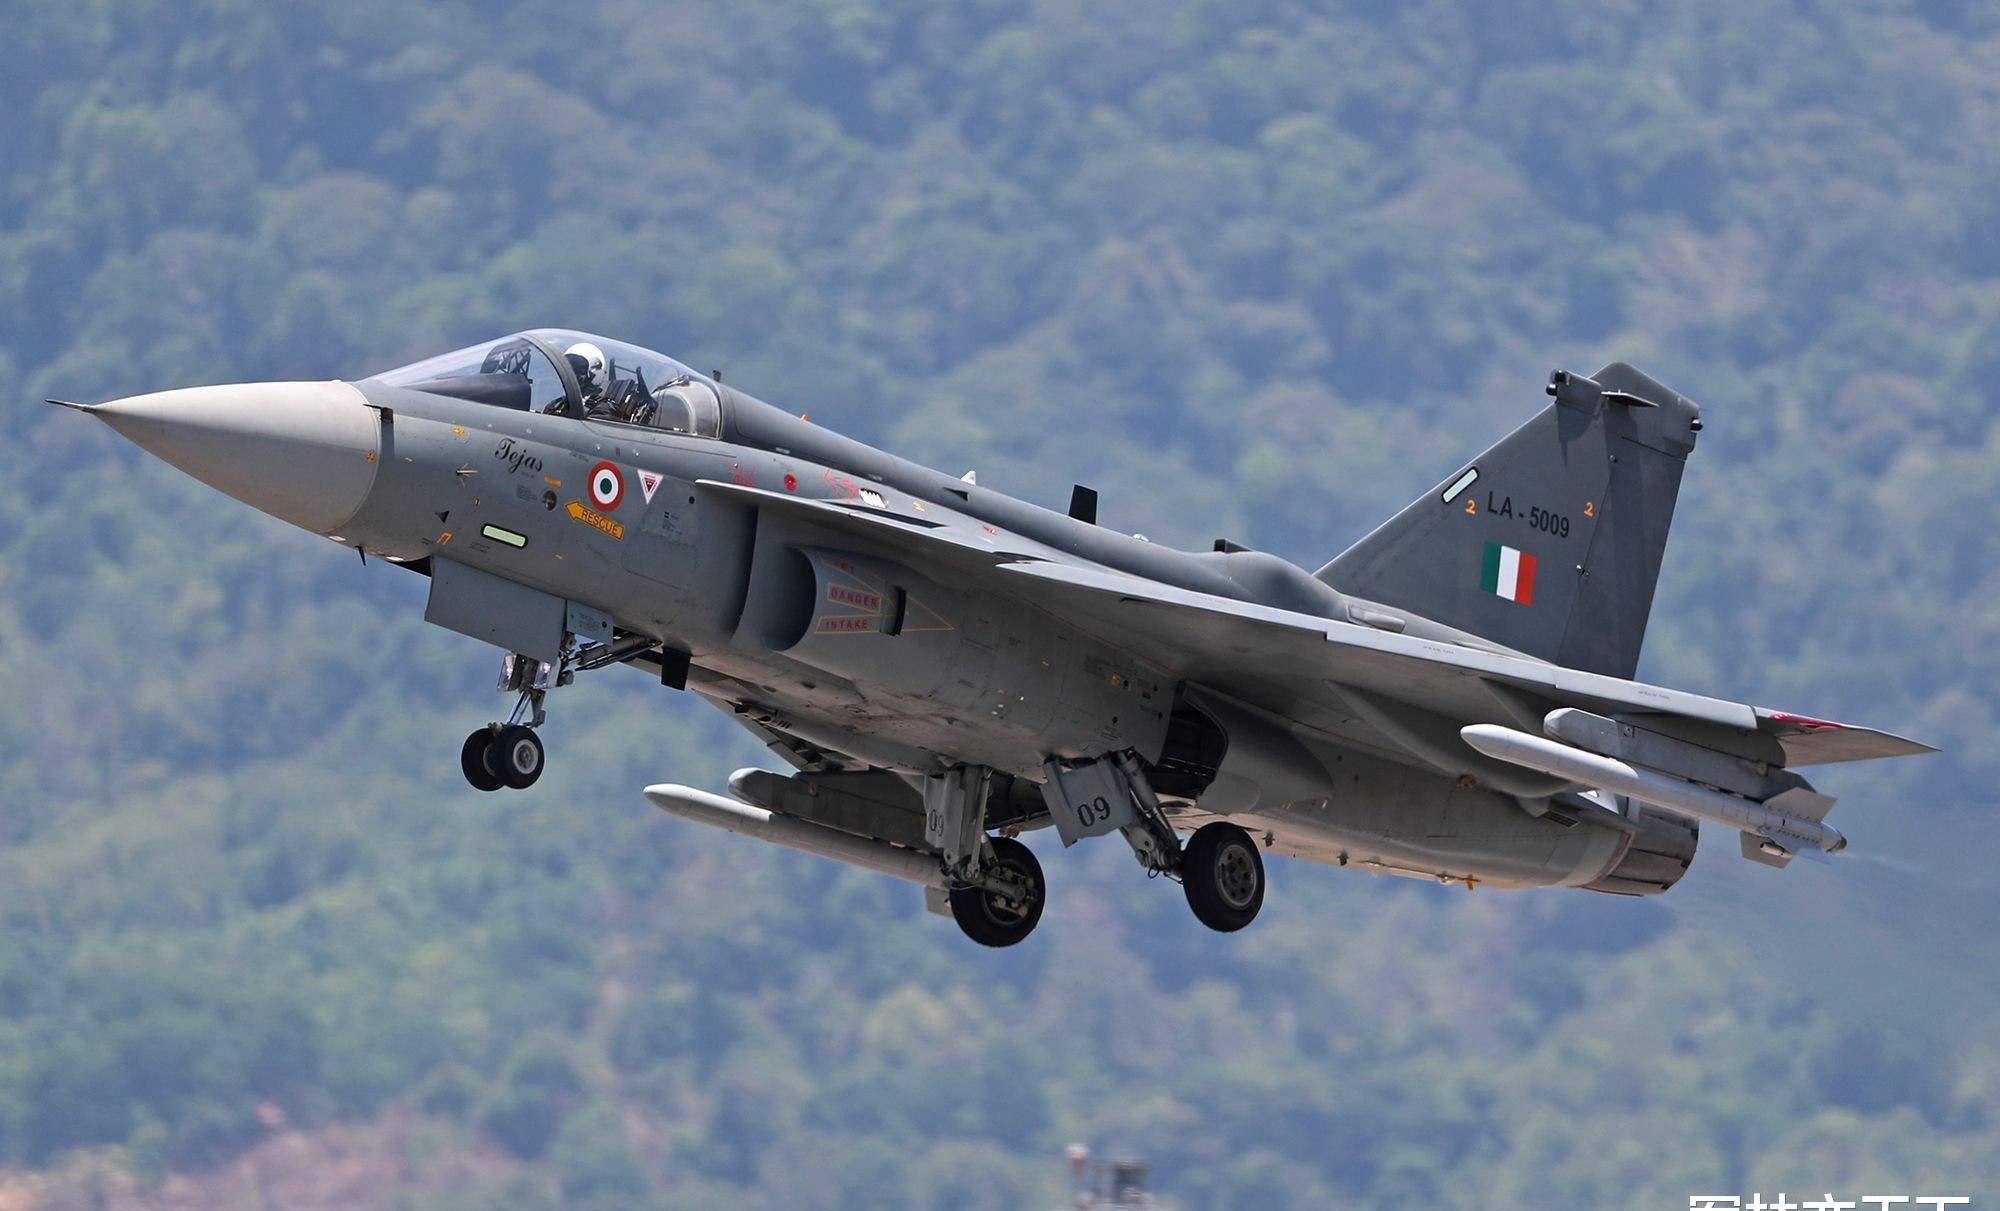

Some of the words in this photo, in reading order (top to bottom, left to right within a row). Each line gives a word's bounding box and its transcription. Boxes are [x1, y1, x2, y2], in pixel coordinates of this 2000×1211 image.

[495, 438, 543, 473] Tejas
[1465, 498, 1477, 516] 2
[1584, 502, 1596, 518] 2
[582, 510, 619, 534] RESCUE
[831, 588, 880, 606] DANGER
[825, 619, 868, 629] INTAKE
[1077, 797, 1112, 827] 09
